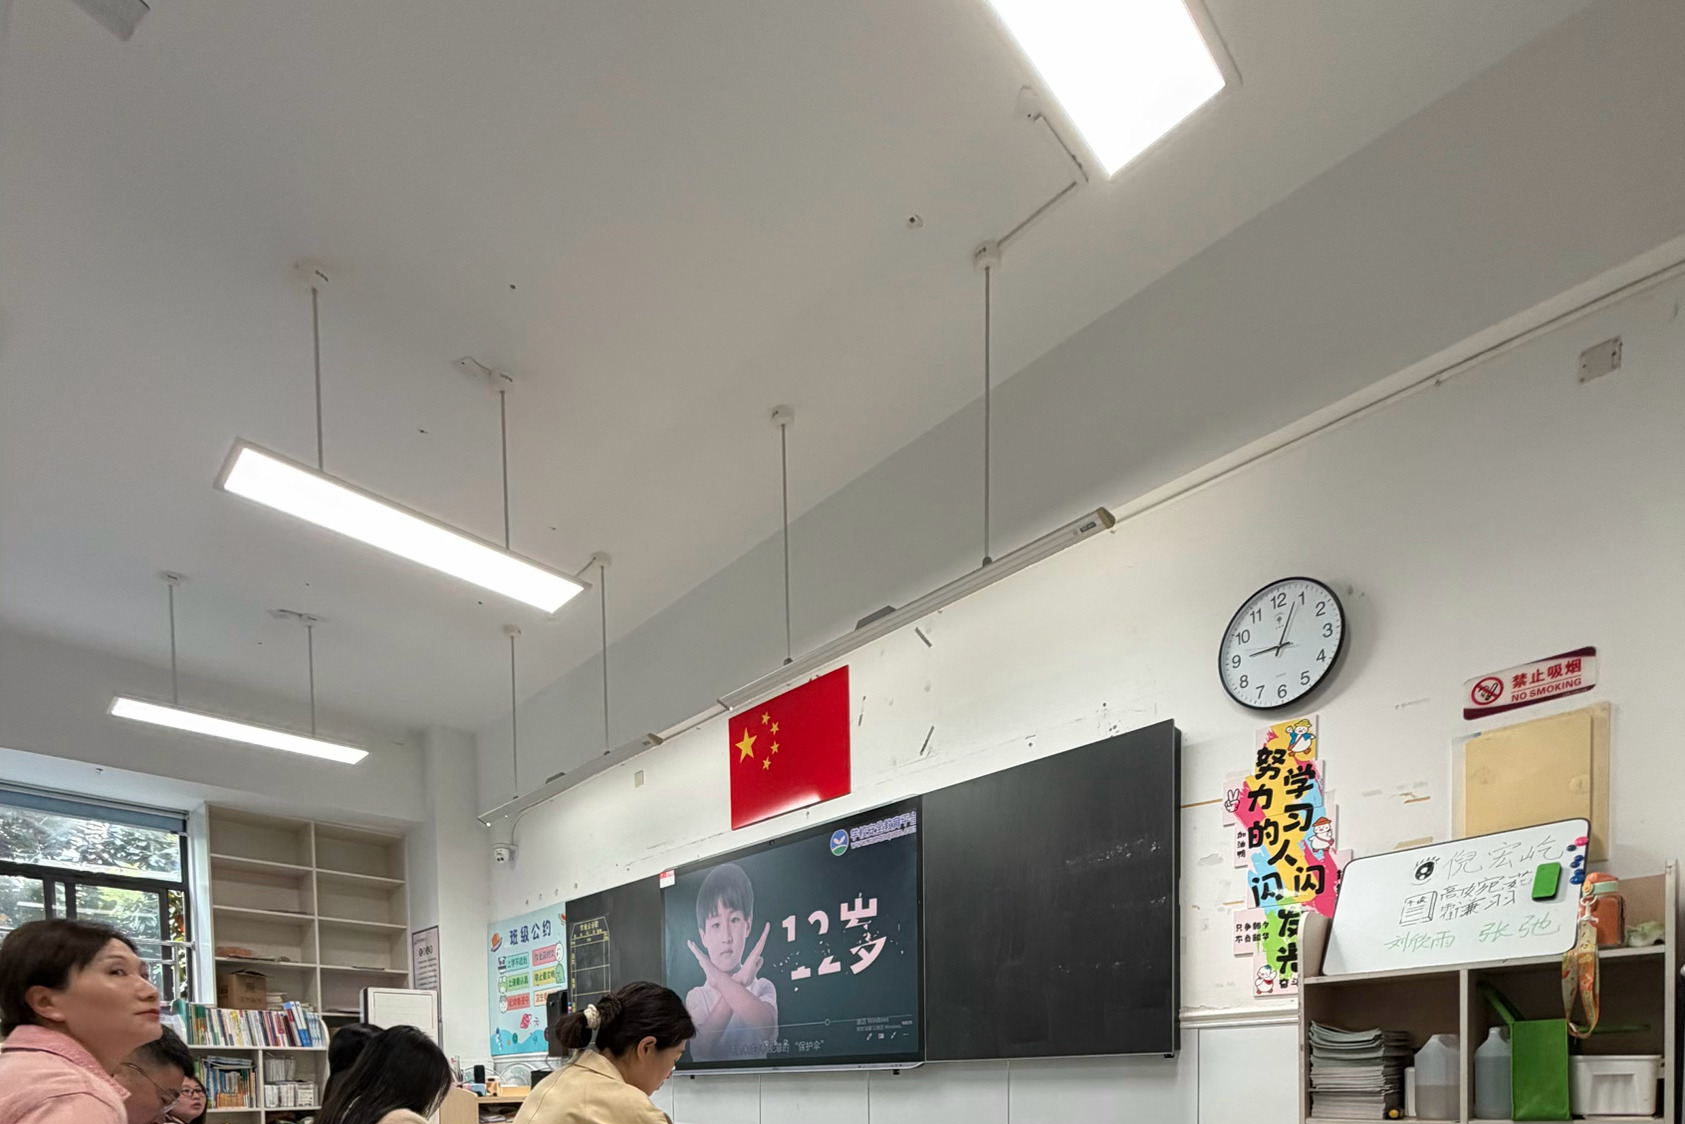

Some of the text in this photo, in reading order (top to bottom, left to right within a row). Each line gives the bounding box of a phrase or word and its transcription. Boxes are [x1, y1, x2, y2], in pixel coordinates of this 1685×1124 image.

[1270, 592, 1287, 610] 12
[1298, 591, 1305, 605] 1
[1249, 608, 1262, 624] 11
[1315, 601, 1326, 617] 2
[1235, 629, 1251, 645] 10
[1322, 623, 1333, 638] 3
[1231, 654, 1242, 669] 9
[1316, 648, 1327, 663] 4
[1239, 674, 1249, 689] 8
[1300, 670, 1311, 686] 5
[1511, 658, 1582, 689] 禁止吸烟
[1255, 685, 1265, 699] 7
[1277, 684, 1287, 699] 6
[1511, 692, 1527, 702] NO
[1529, 678, 1582, 698] SMOKING
[509, 920, 552, 946] 班级公约
